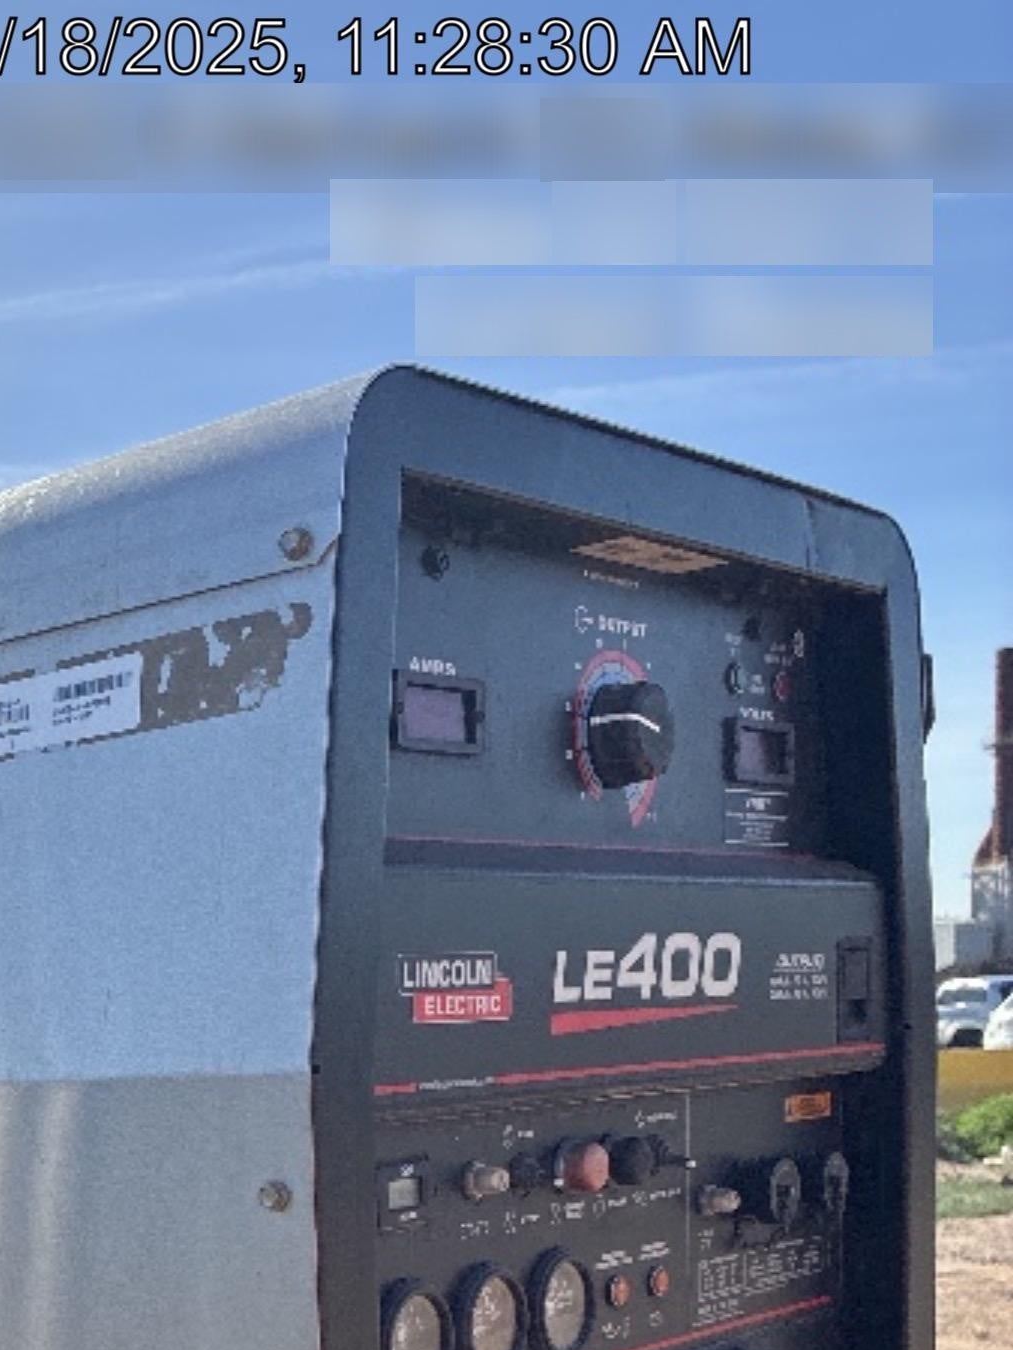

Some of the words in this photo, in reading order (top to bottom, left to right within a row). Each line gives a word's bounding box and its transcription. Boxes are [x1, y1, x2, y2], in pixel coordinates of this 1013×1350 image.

[403, 959, 493, 988] LINCOLN
[553, 932, 742, 1004] LE400
[424, 994, 502, 1016] ELECTRIC
